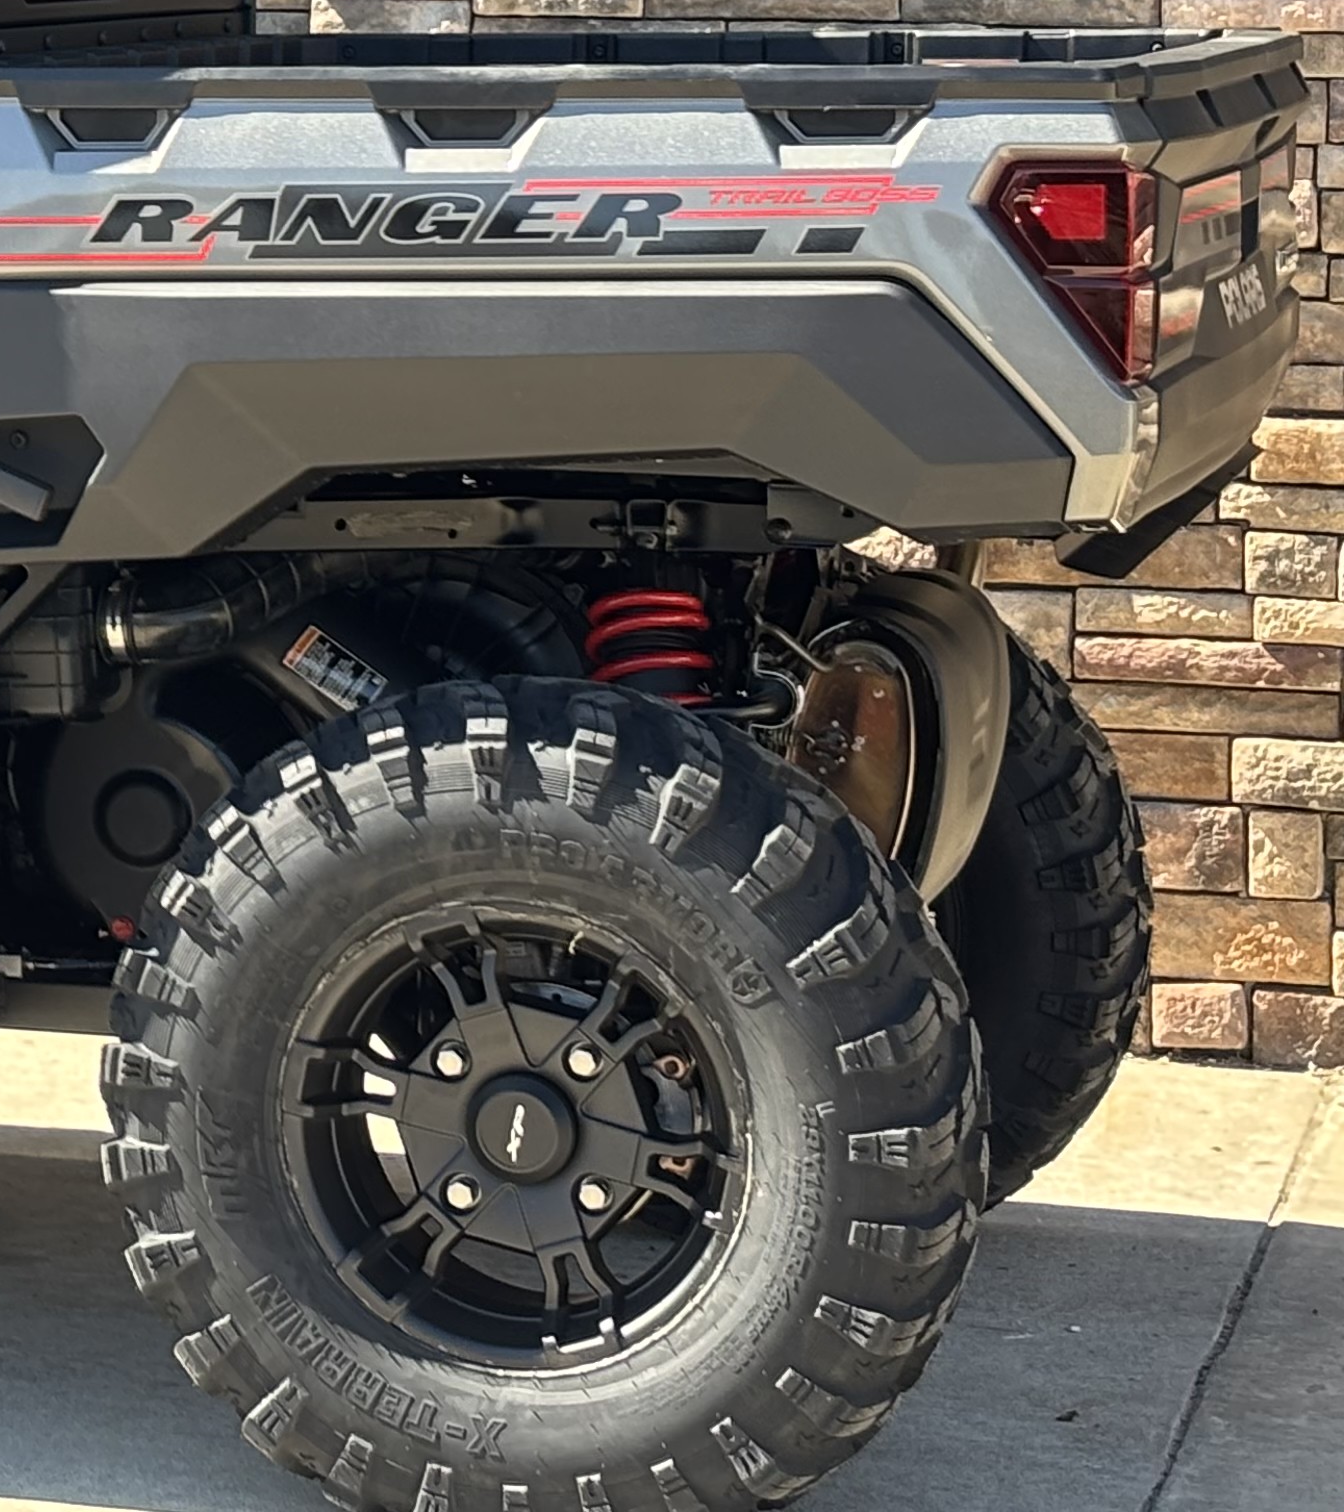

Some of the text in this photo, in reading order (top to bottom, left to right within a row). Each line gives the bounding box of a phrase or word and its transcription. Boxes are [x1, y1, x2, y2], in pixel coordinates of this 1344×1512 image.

[88, 191, 684, 244] RANGER
[709, 185, 943, 204] TRAIL BOSS
[246, 1274, 509, 1464] X-TERRAIN
